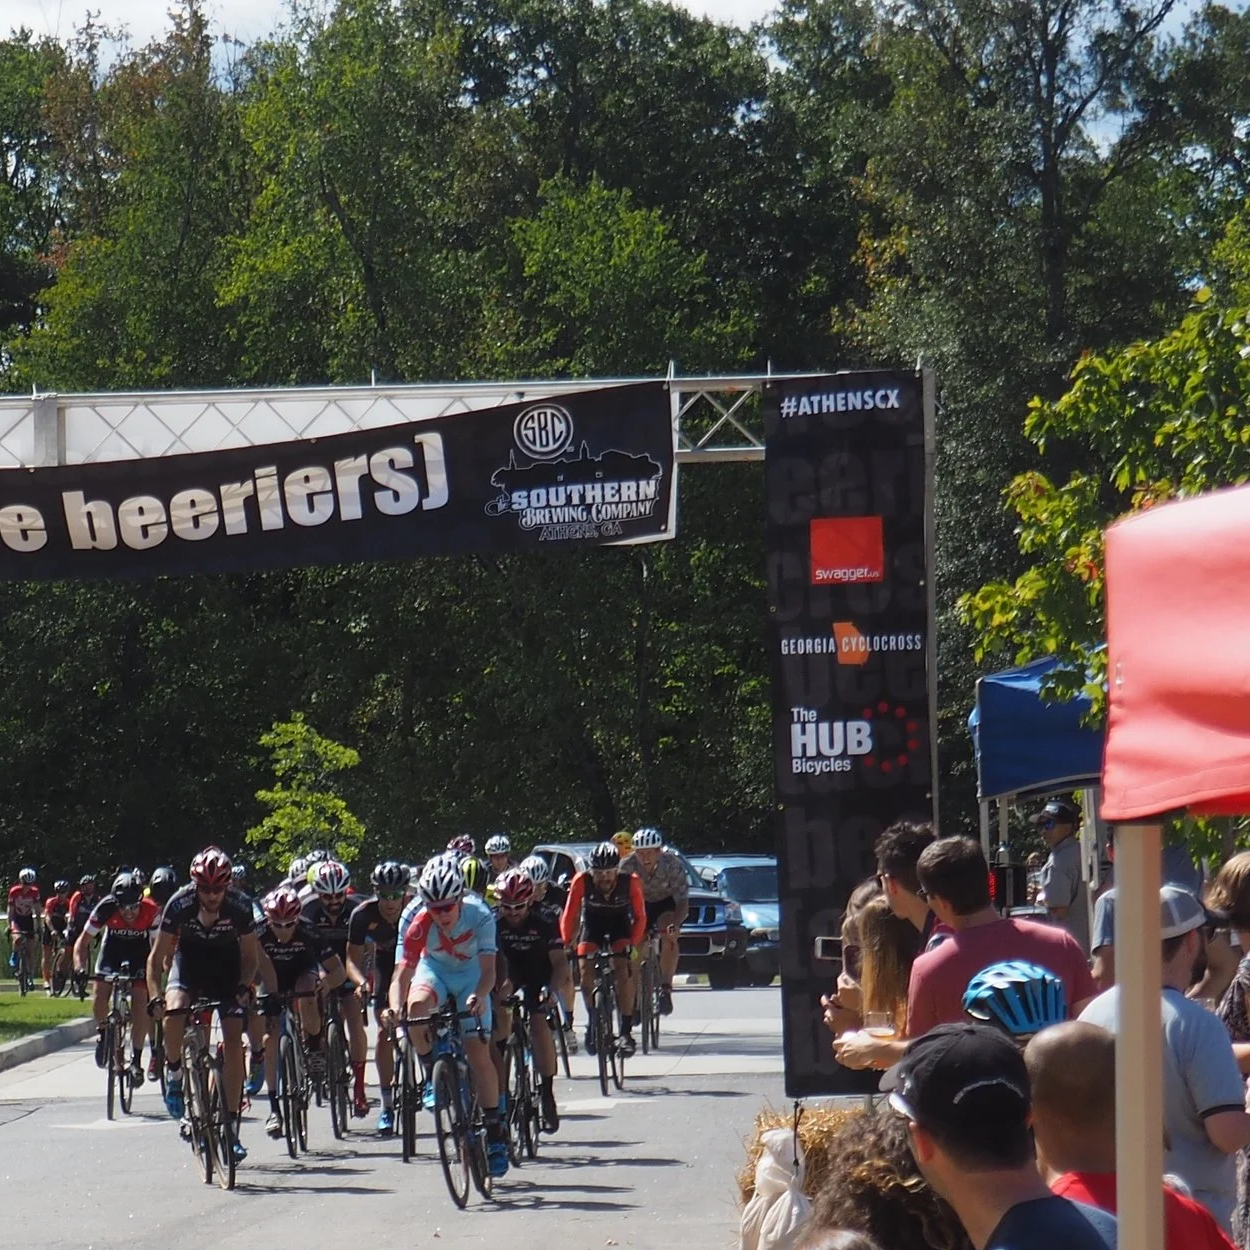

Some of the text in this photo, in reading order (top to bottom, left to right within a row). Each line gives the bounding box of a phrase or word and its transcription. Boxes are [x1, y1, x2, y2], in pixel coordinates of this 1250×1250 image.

[780, 388, 900, 418] #ATHENSCX
[523, 411, 565, 449] SBC
[511, 480, 656, 510] SOUTHERN
[521, 500, 652, 527] BREWING COMPANY
[781, 634, 921, 655] GEORGIA CYCLOCROSS
[790, 707, 817, 722] The
[790, 721, 873, 757] HUB
[792, 756, 851, 775] Bicycles
